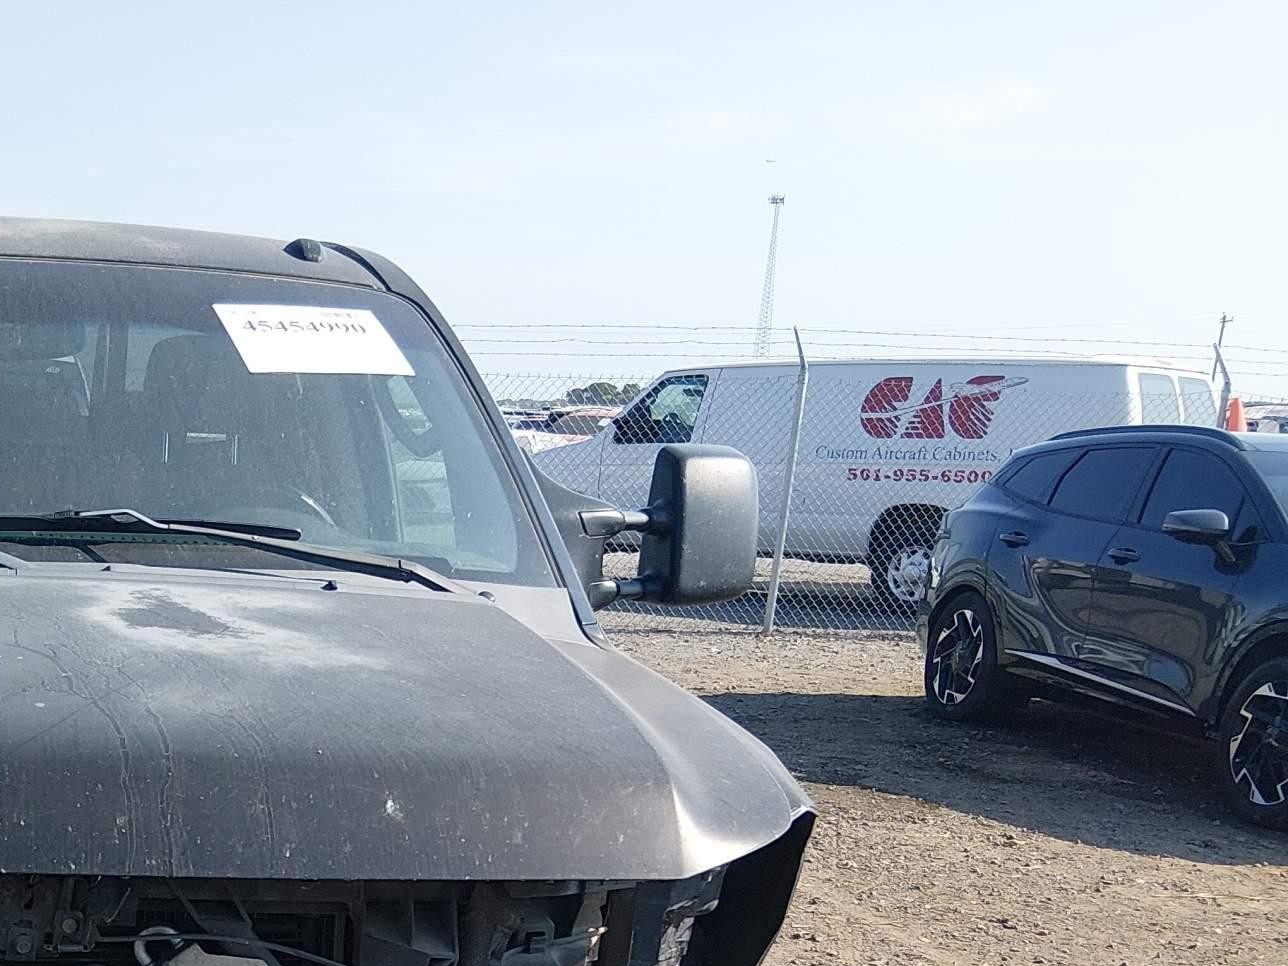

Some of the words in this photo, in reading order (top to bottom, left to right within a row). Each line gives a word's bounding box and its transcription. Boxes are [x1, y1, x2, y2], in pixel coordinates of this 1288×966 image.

[242, 319, 367, 334] 45454990
[815, 445, 868, 461] Custom
[871, 446, 927, 461] Aircraft
[931, 447, 1002, 463] Cabinets,
[846, 467, 993, 484] 501-955-6500
